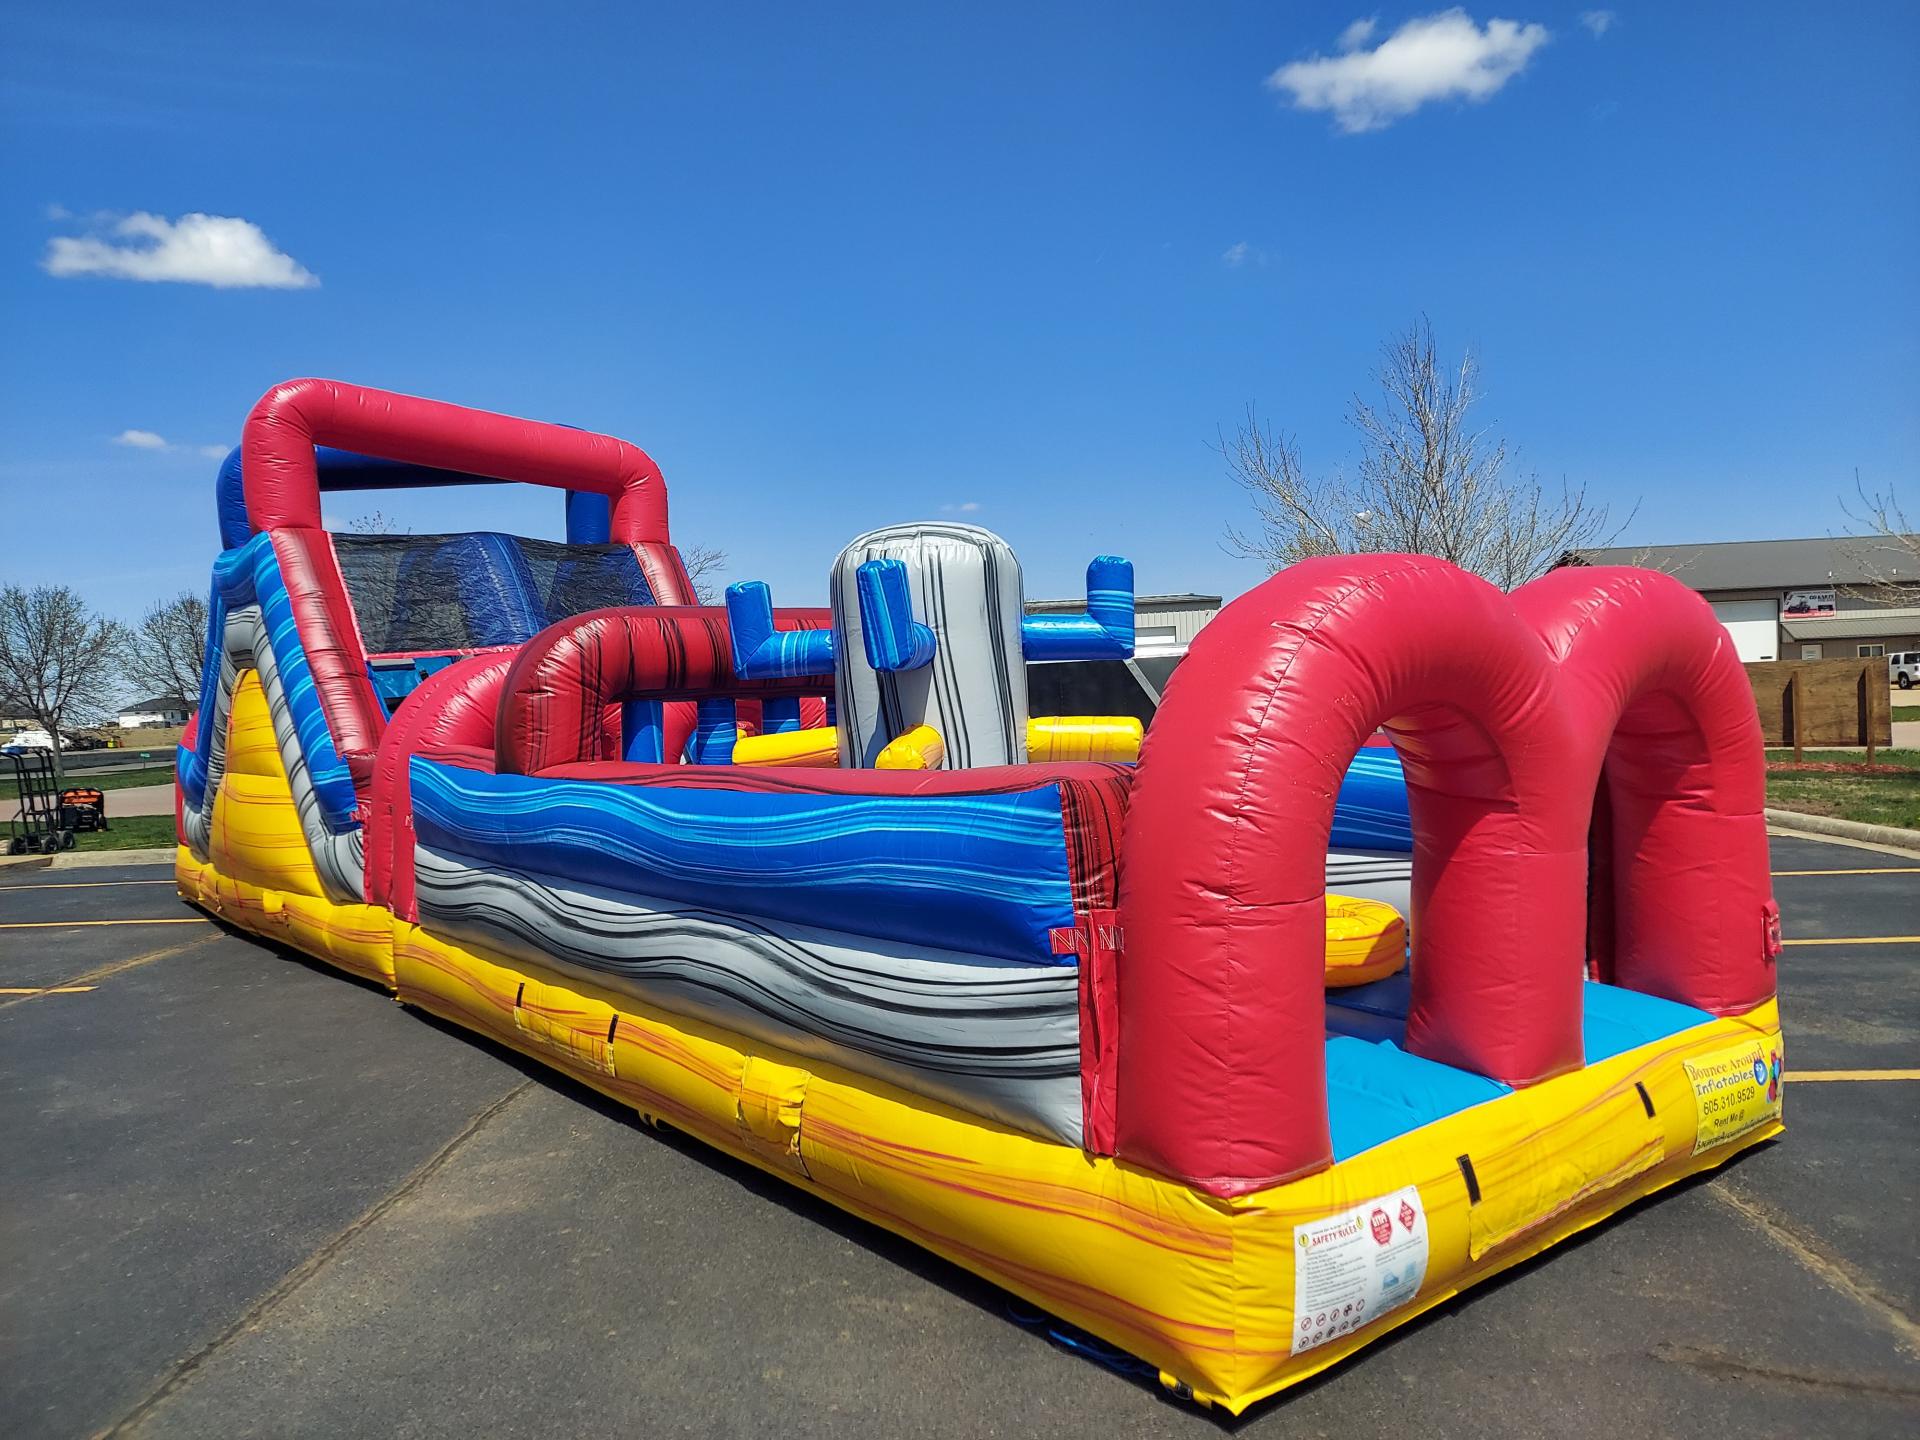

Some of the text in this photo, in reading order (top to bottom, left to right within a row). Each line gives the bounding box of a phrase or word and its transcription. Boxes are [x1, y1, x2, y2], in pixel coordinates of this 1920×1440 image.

[1687, 1042, 1765, 1082] Bounce Around
[1695, 1069, 1754, 1096] Inflatables
[1703, 1086, 1755, 1115] 605.310.9529
[1714, 1116, 1728, 1128] Rent
[1312, 1232, 1337, 1246] SAFETY
[1339, 1224, 1357, 1238] RULES
